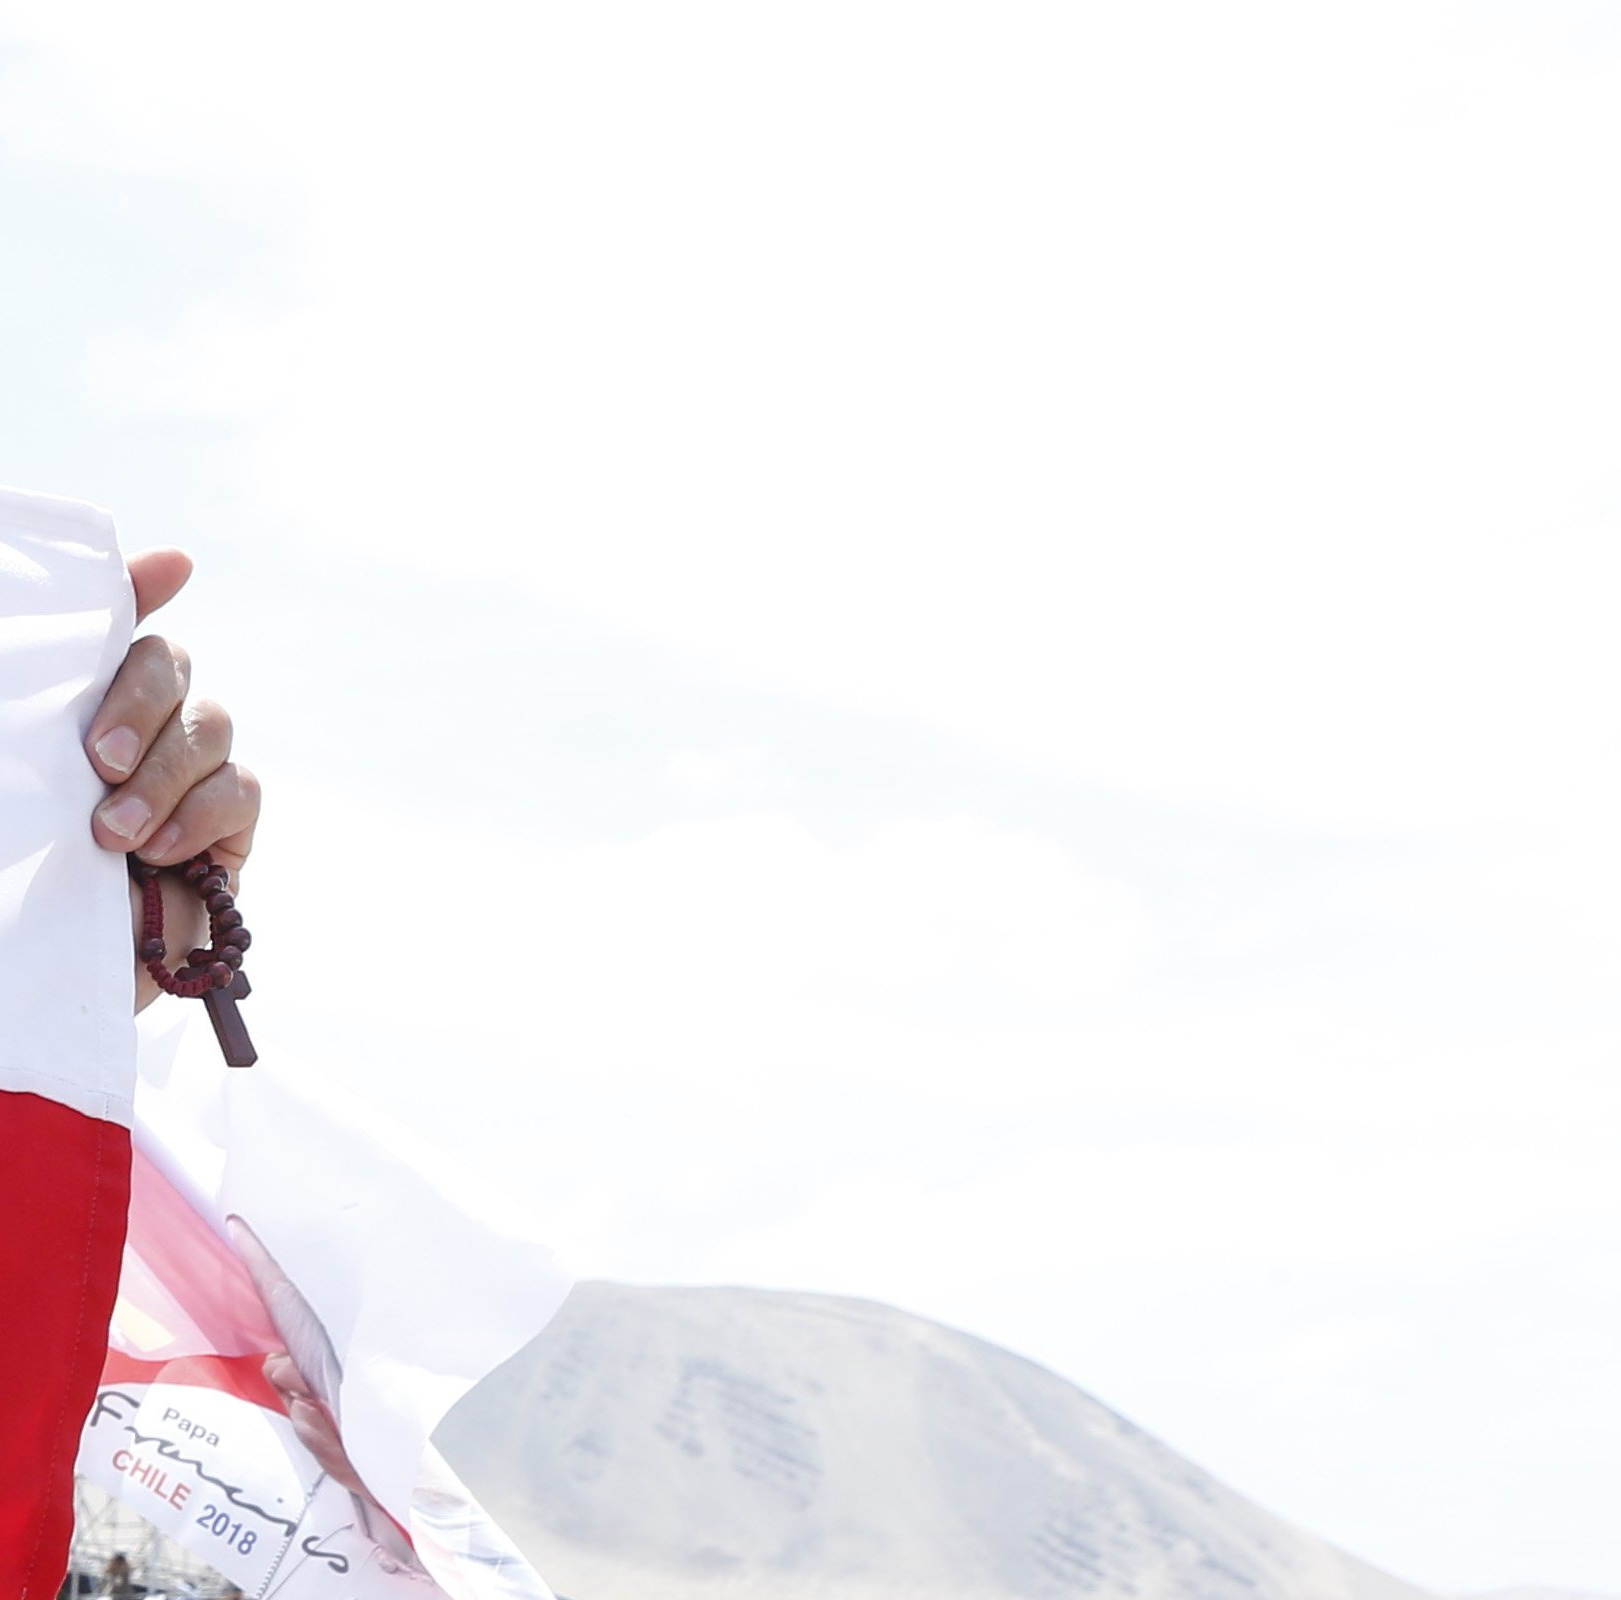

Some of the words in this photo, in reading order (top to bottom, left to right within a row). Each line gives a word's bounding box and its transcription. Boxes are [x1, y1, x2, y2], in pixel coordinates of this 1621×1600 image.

[161, 1406, 220, 1448] Papa
[112, 1449, 192, 1511] CHILE
[195, 1503, 258, 1556] 2018
